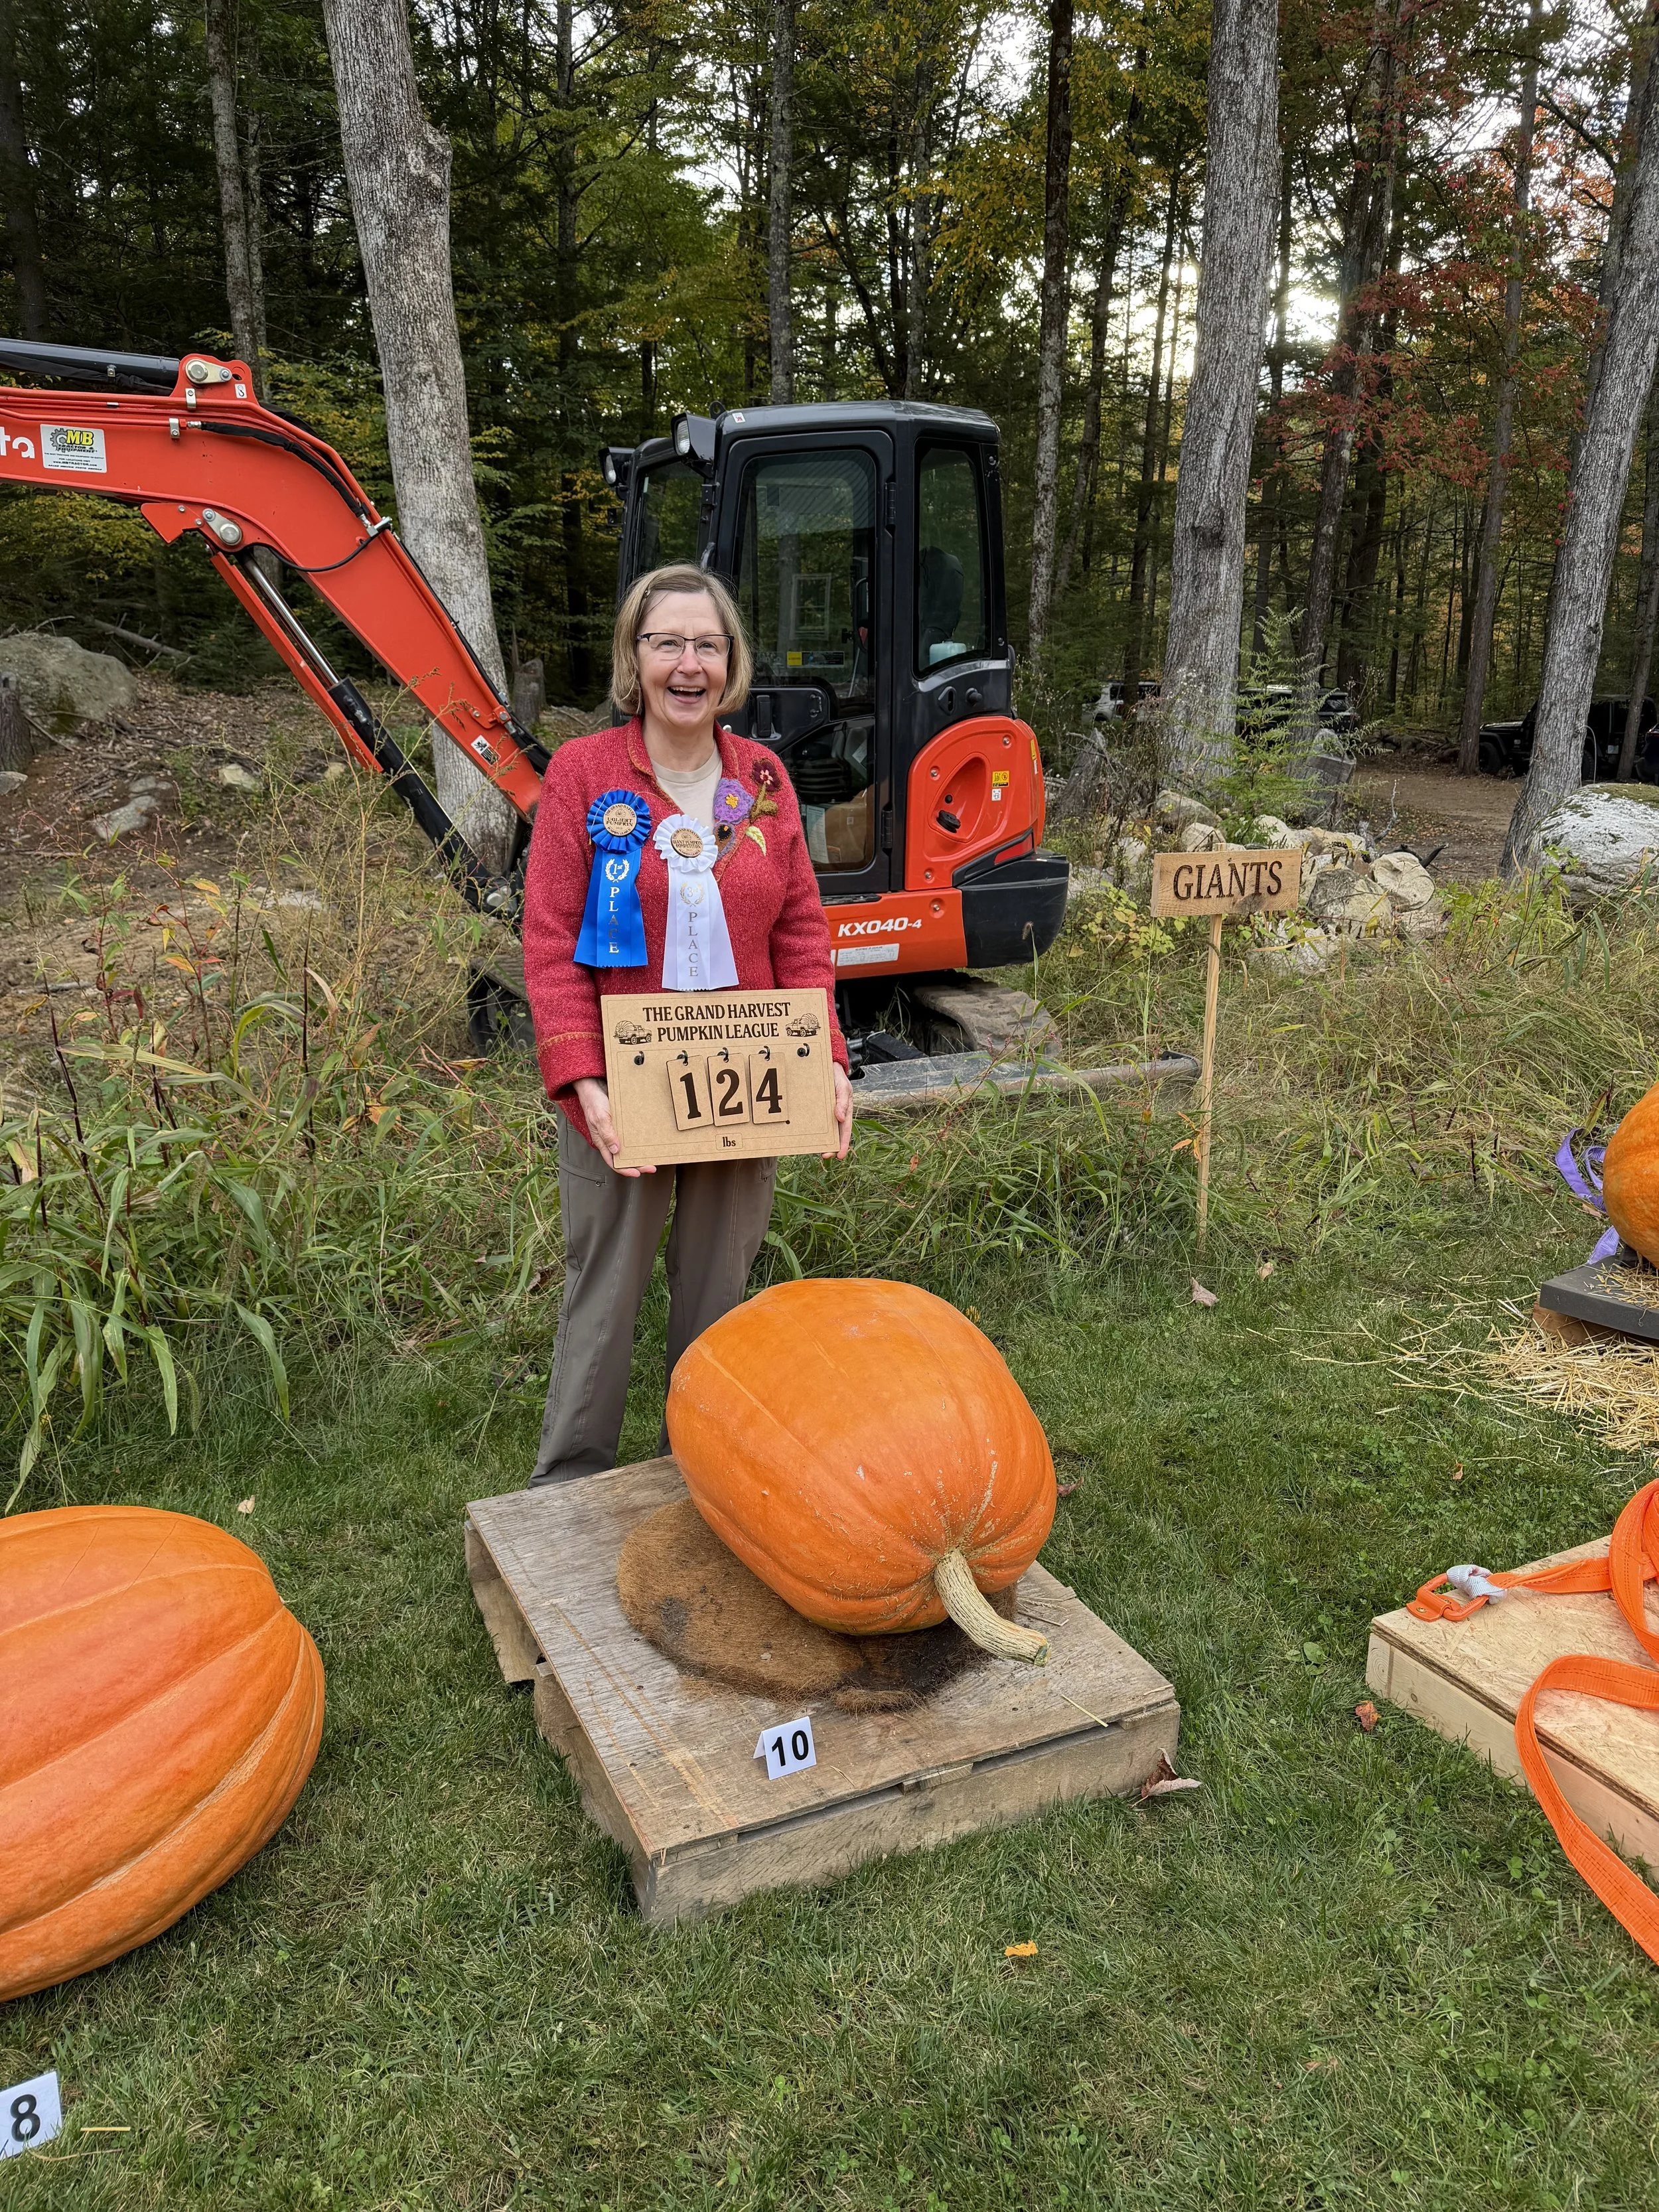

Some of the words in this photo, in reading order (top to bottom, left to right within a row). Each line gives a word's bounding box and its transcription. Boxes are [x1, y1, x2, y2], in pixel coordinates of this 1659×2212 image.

[66, 429, 94, 446] MB
[612, 863, 623, 875] 1st
[1173, 860, 1283, 901] GIANTS
[608, 887, 620, 953] PLACE
[837, 917, 922, 937] KX040-4
[688, 912, 699, 977] PLACE
[642, 1006, 673, 1022] THE
[674, 1004, 725, 1021] GRAND
[728, 1002, 790, 1019] HARVEST
[657, 1024, 723, 1042] PUMPKIN
[725, 1023, 779, 1039] LEAGUE
[722, 1136, 737, 1147] lbs
[771, 1730, 809, 1767] 10
[10, 2094, 40, 2142] 8
